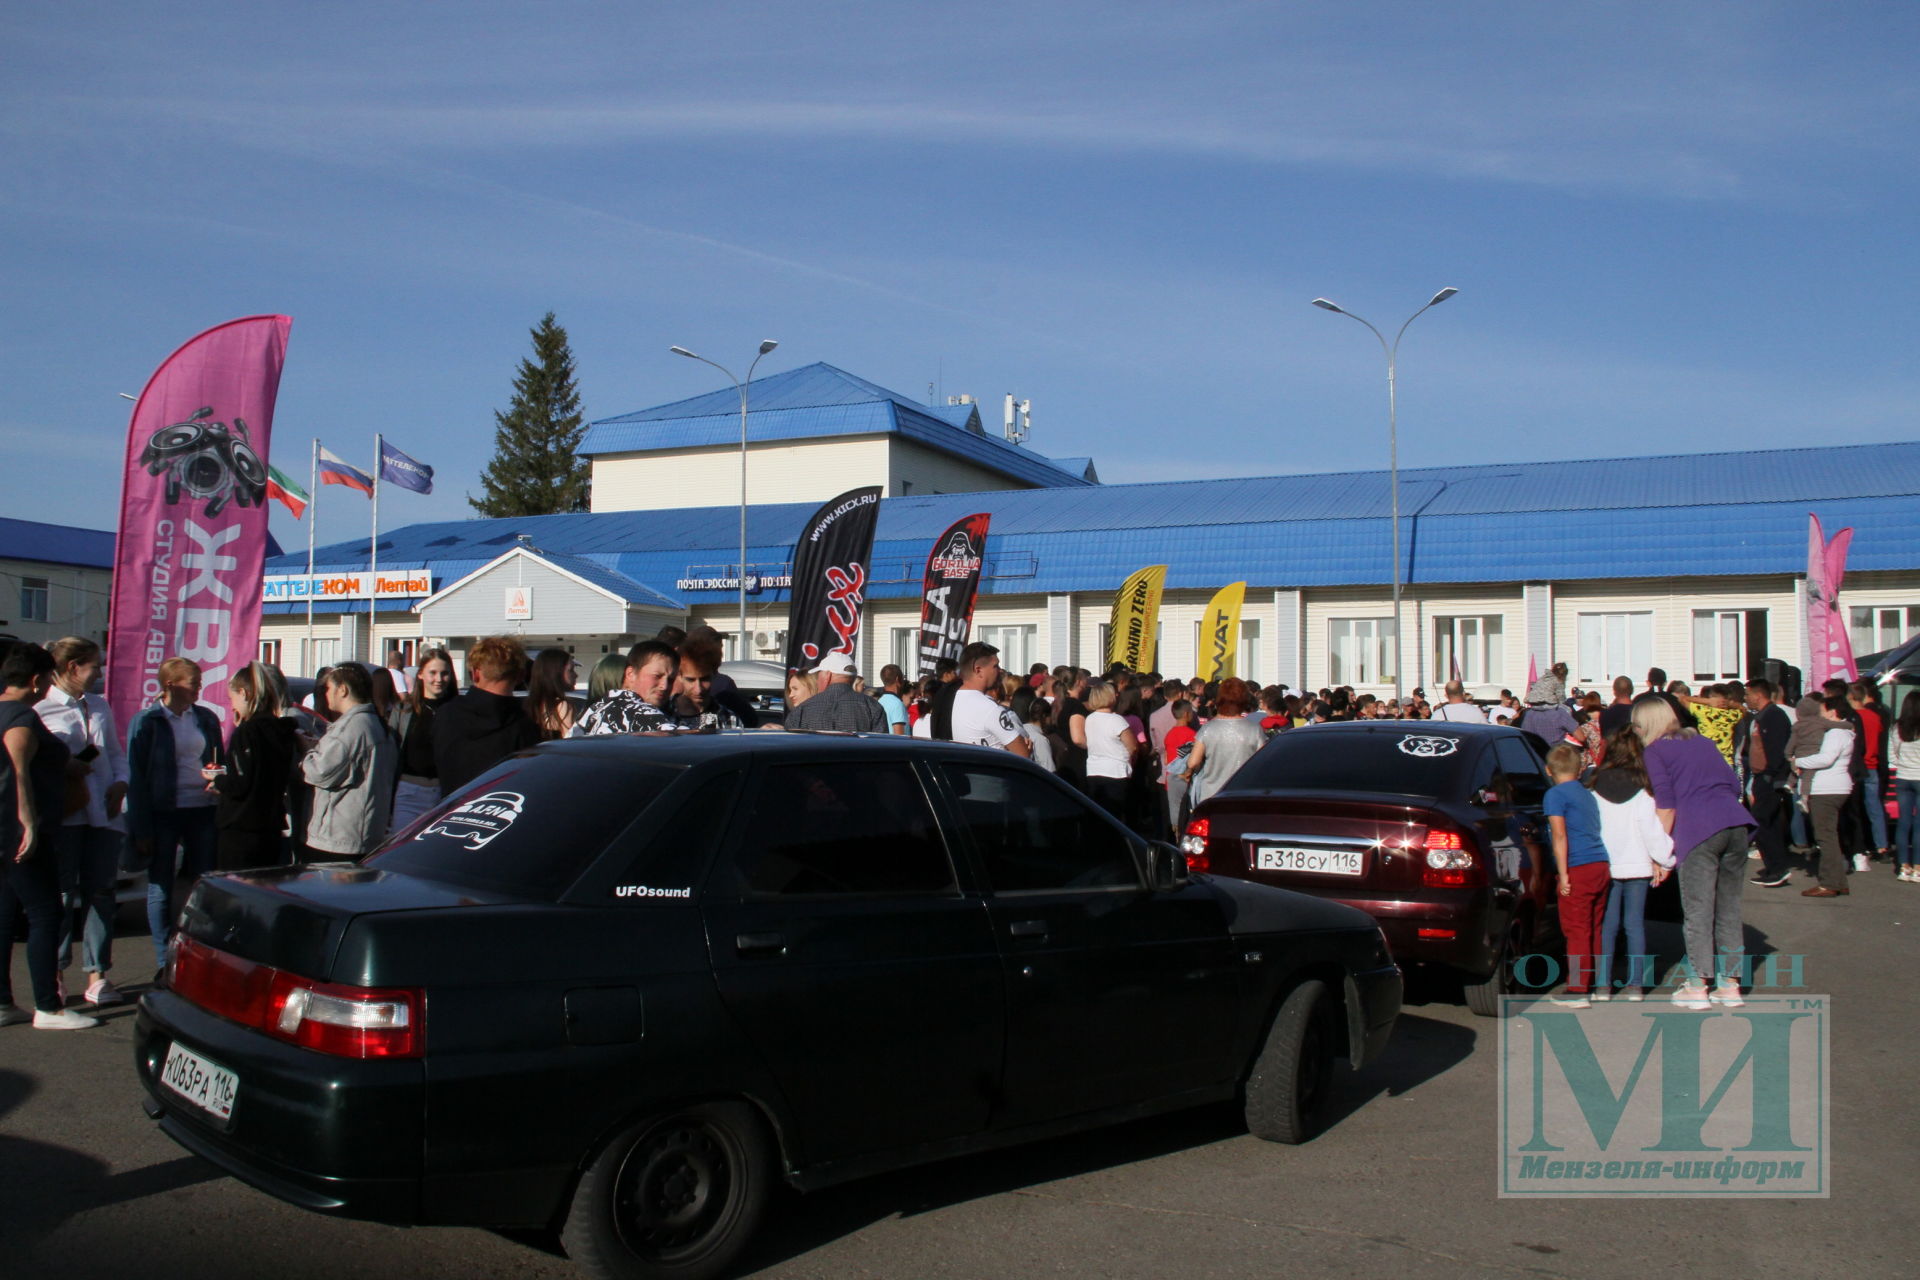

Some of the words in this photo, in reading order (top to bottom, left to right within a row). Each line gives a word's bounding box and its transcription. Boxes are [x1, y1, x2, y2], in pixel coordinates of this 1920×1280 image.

[810, 494, 877, 542] WWW.KICX.RU
[151, 519, 174, 620] СТУДИЯ
[932, 556, 981, 571] GORILLA
[941, 568, 972, 579] BASS
[264, 578, 359, 597] АТТЕЛЕКОМ
[375, 576, 429, 593] Летай
[677, 579, 704, 590] ПОЧТА
[707, 578, 739, 589] РОССИИ
[1131, 579, 1148, 615] ZERO
[1264, 851, 1328, 869] Р318СУ
[1332, 853, 1358, 868] 116
[616, 886, 691, 898] UFOsound
[214, 1071, 233, 1102] 116
